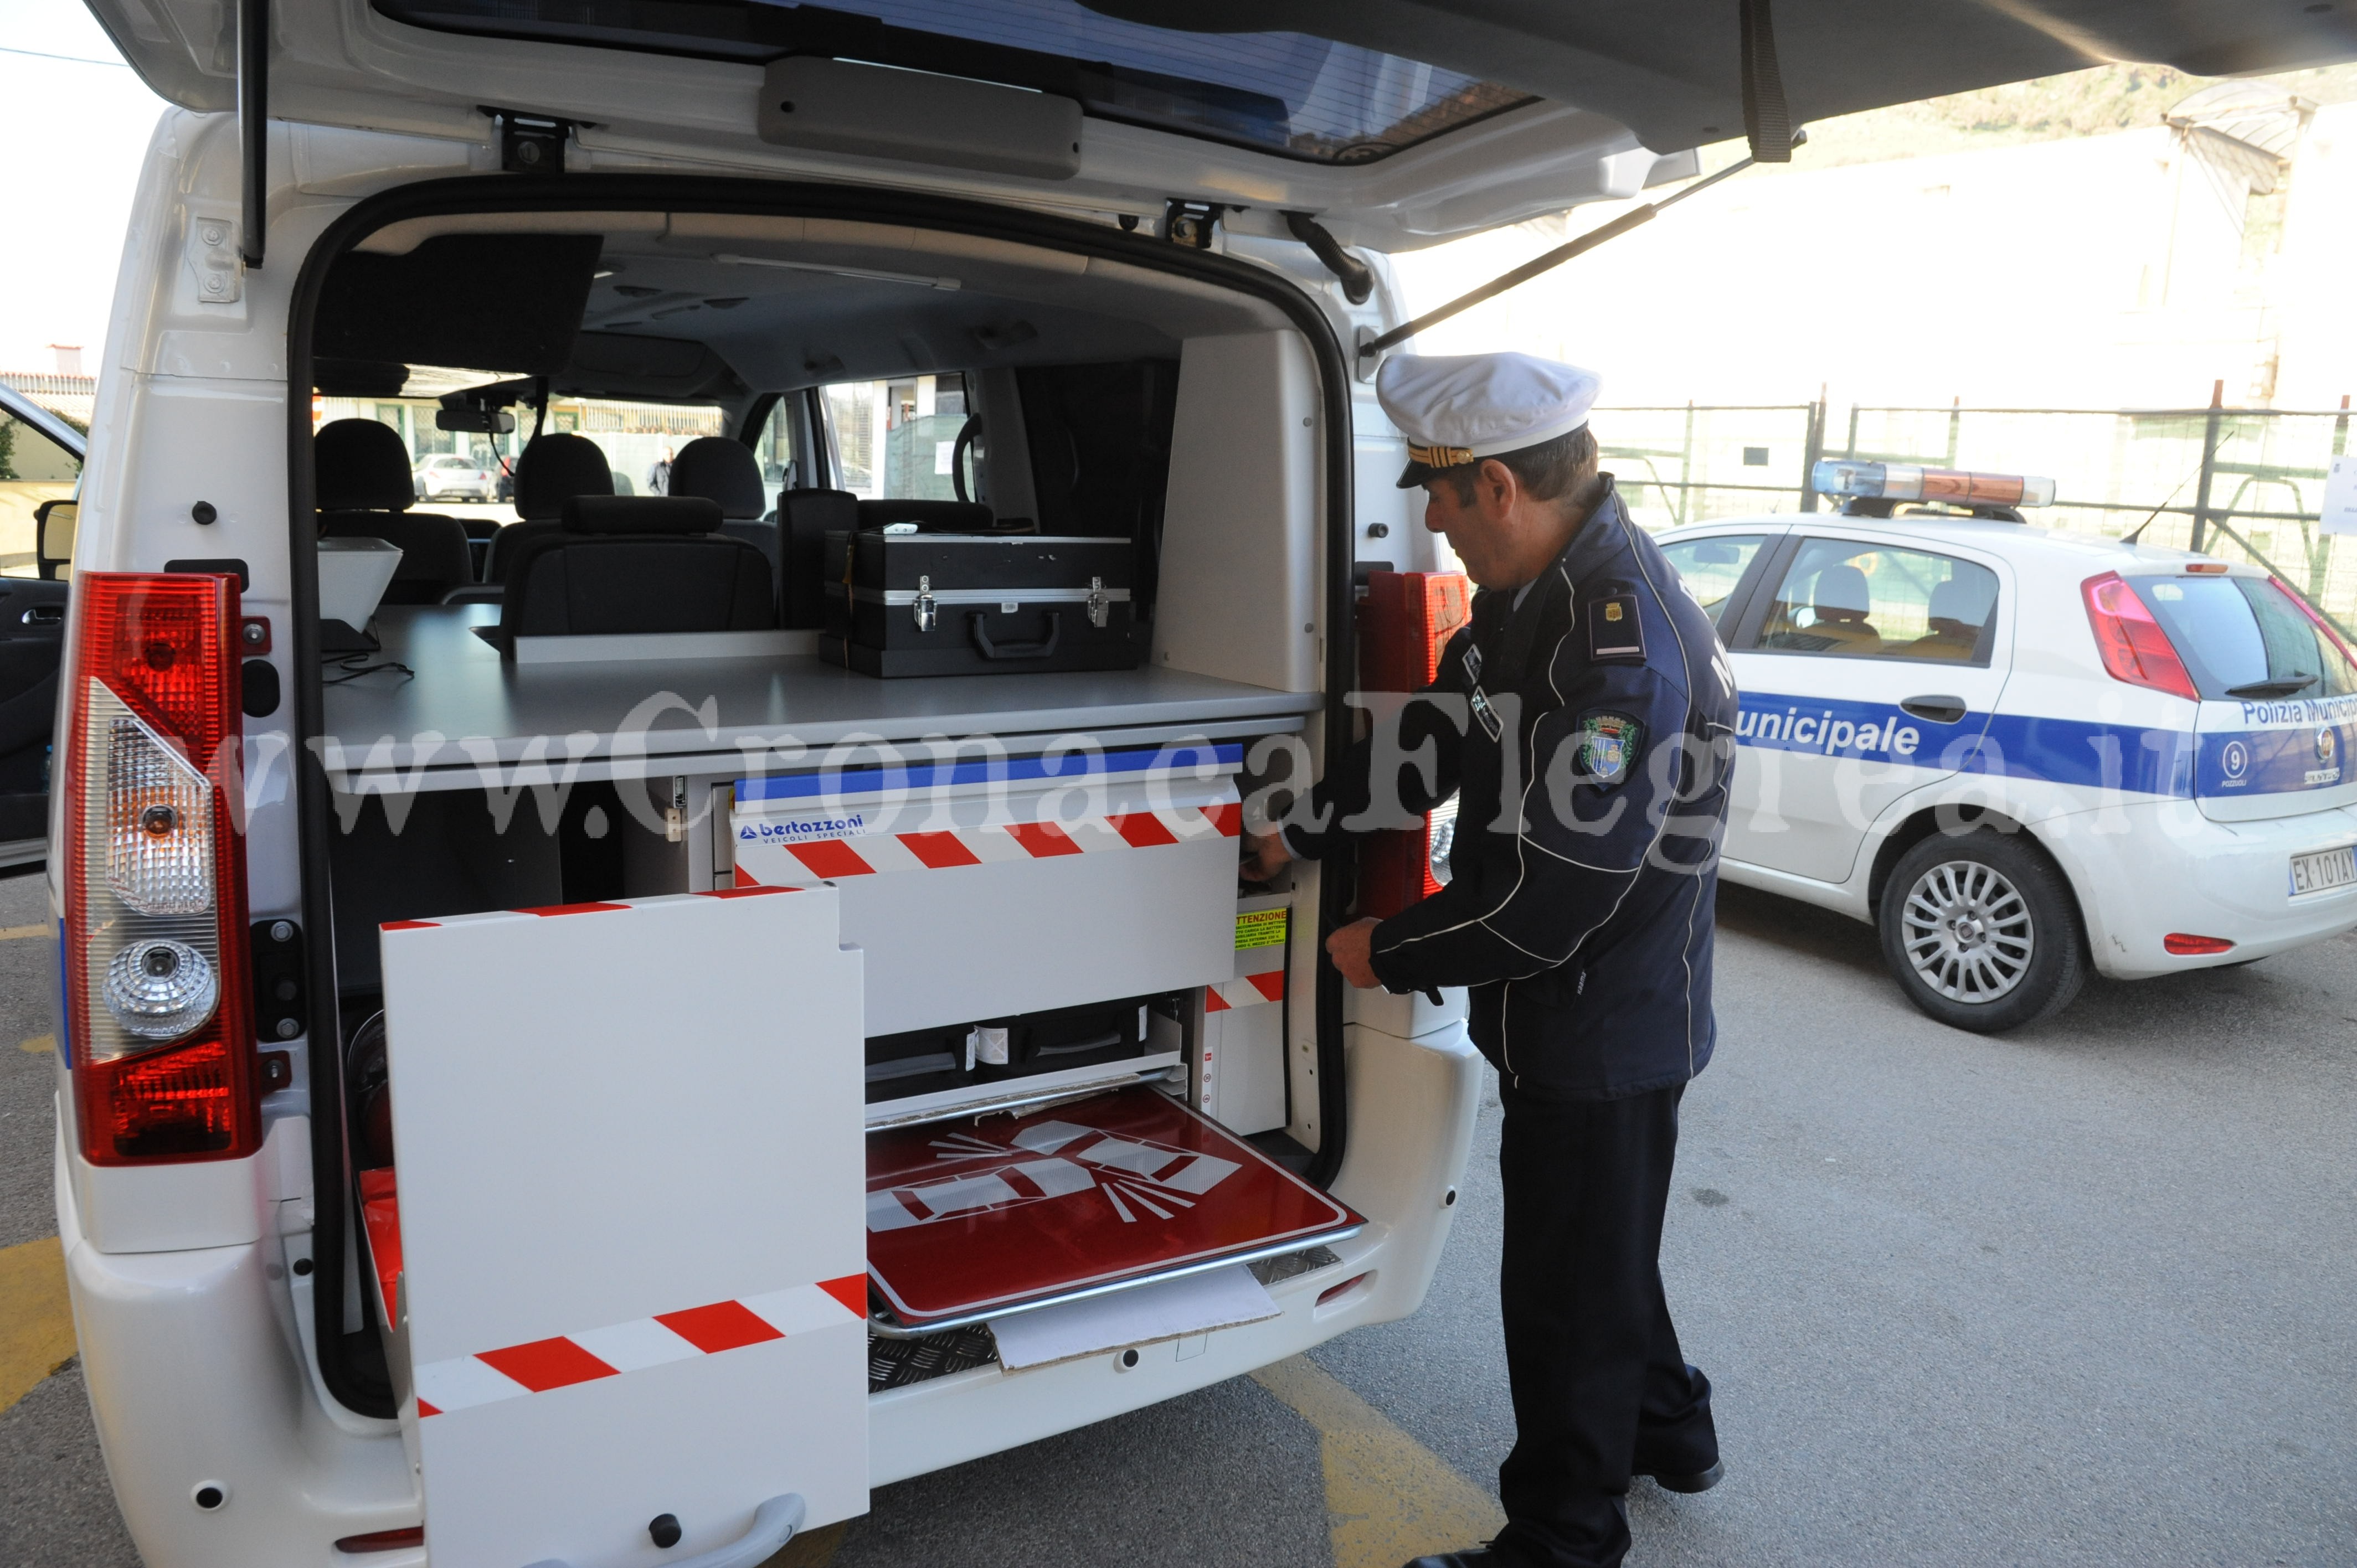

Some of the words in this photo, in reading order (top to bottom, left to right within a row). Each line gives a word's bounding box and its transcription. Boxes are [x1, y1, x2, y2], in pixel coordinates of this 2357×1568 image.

[2240, 700, 2303, 724] Polizia
[2303, 697, 2357, 722] Municip
[1735, 706, 1920, 755] unicipale
[2231, 750, 2241, 771] 9
[2221, 779, 2247, 787] POZZUOLI
[759, 814, 864, 837] bertazzoni
[763, 835, 807, 844] VEICOLI
[816, 829, 866, 839] SPECIALI
[1236, 910, 1287, 925] TTENZIONE
